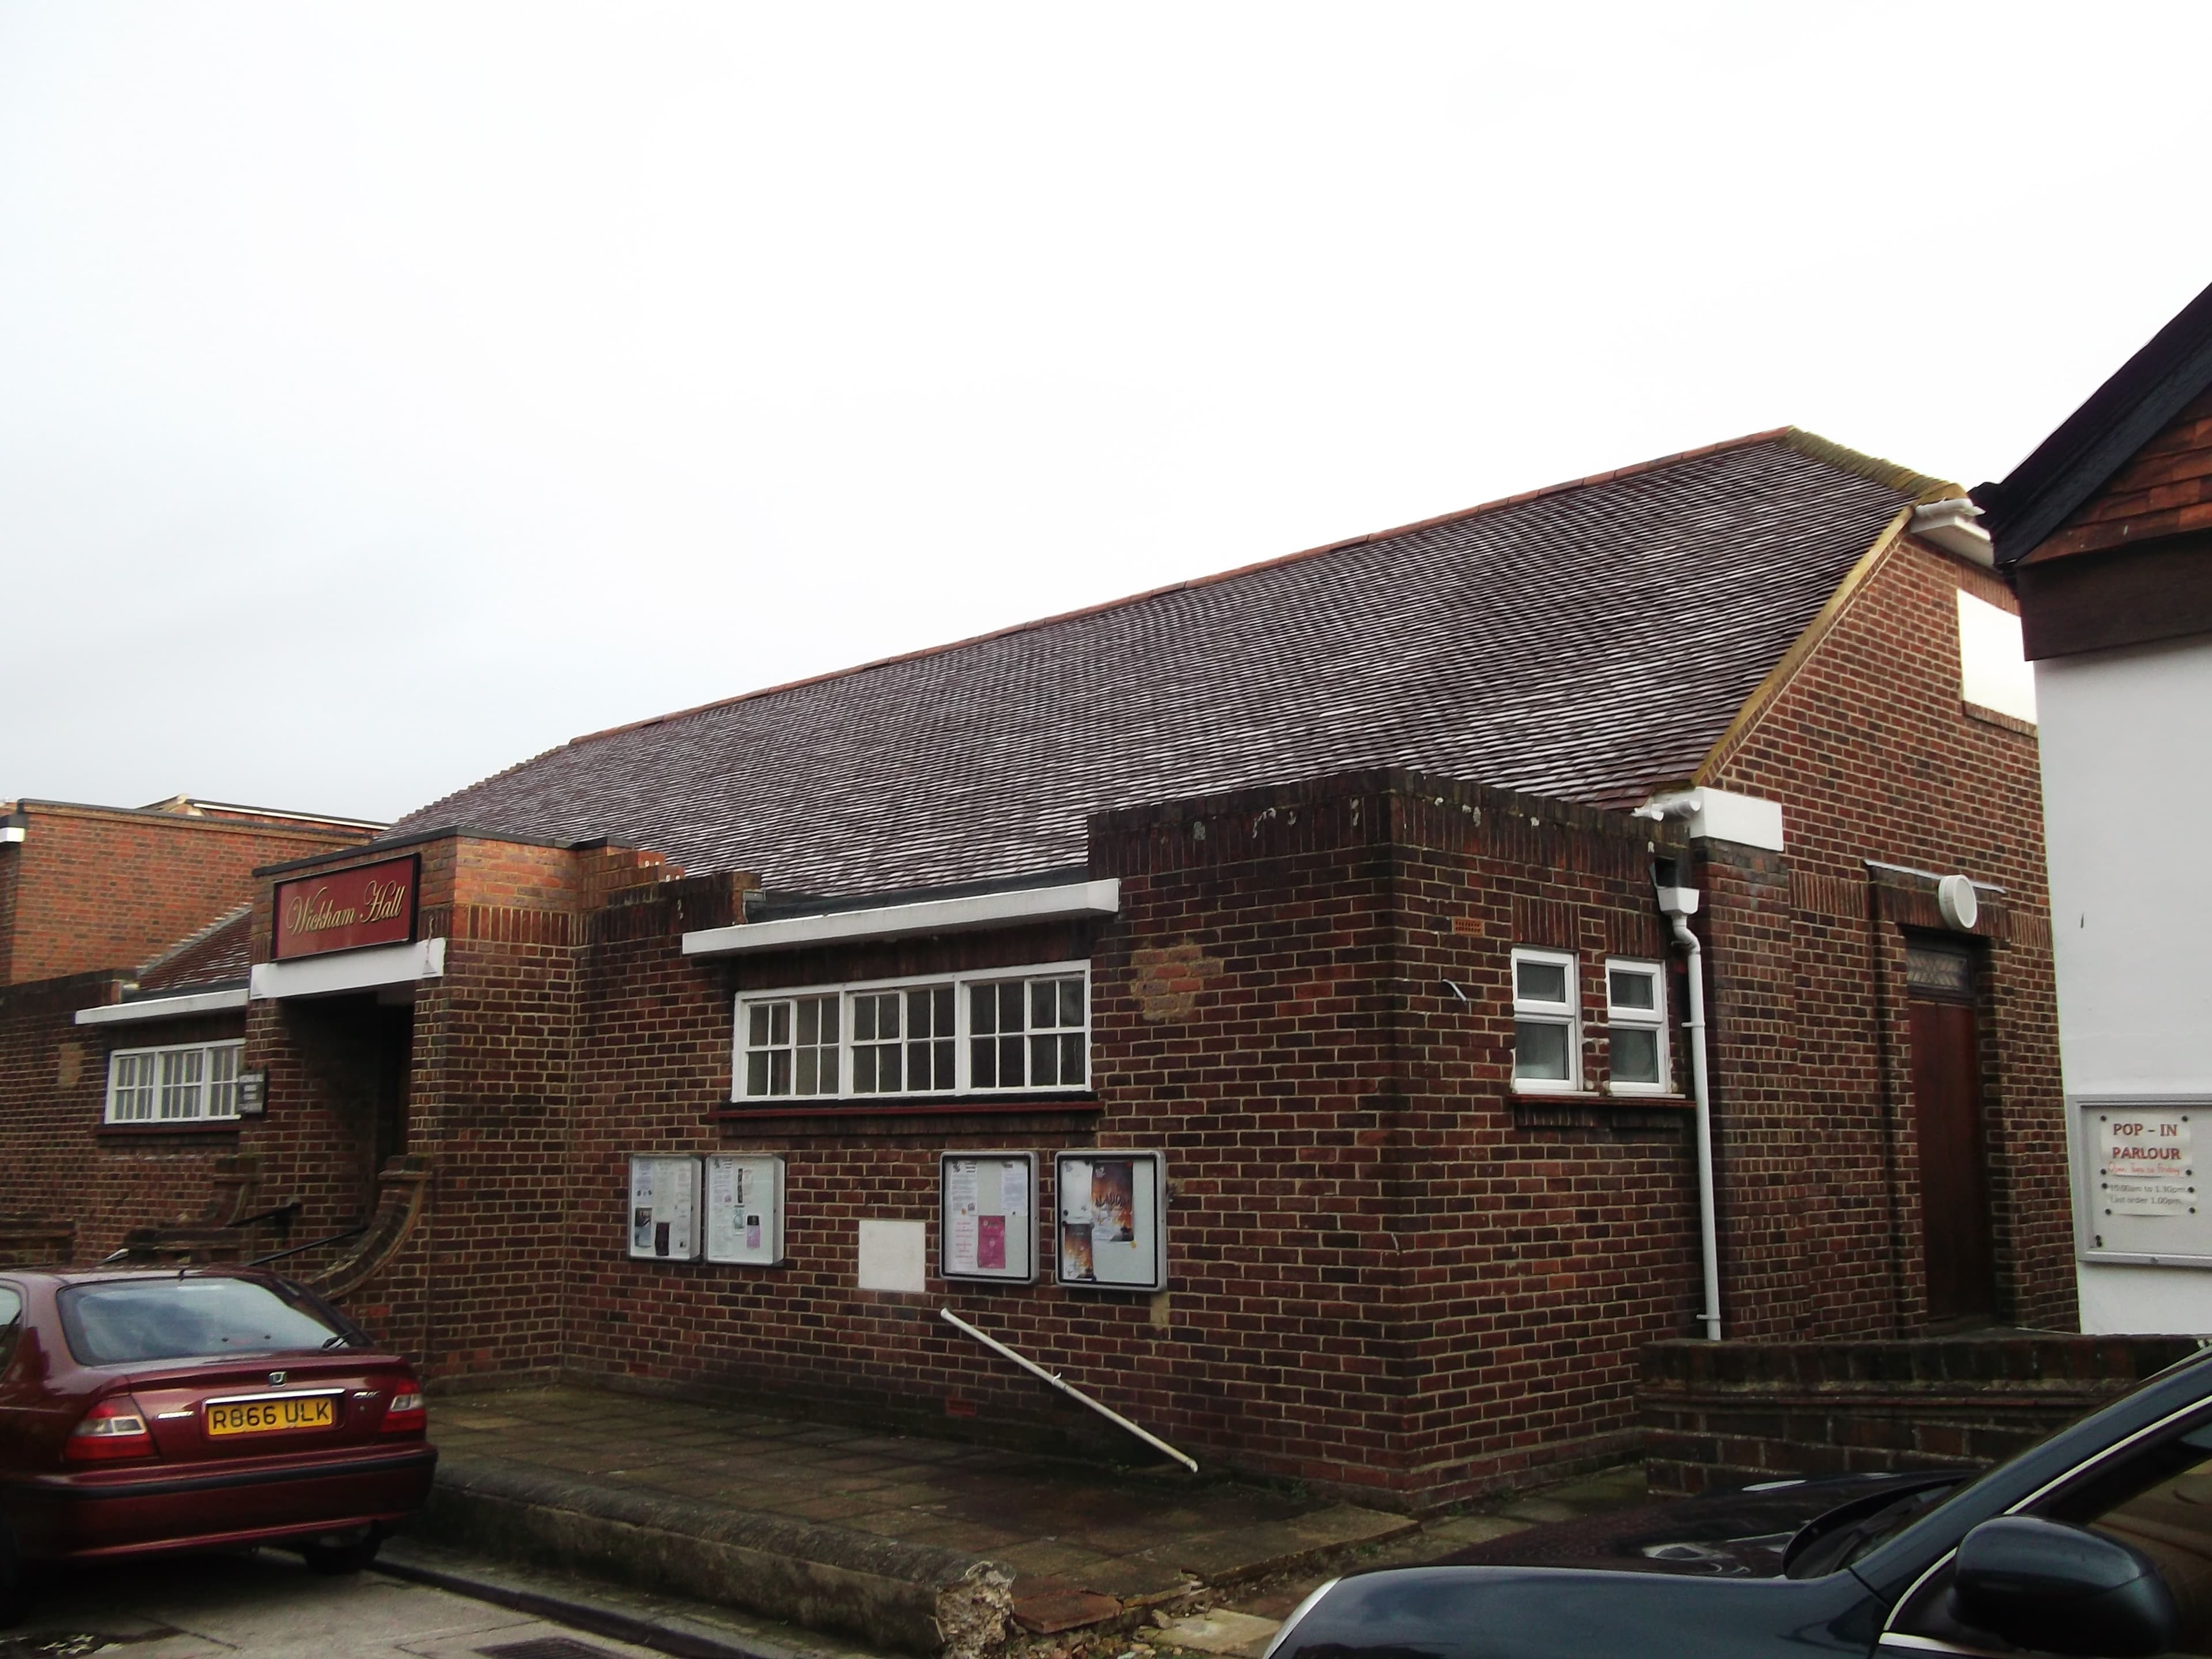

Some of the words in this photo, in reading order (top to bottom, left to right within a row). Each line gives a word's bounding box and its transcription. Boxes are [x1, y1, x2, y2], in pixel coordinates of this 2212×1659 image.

[286, 886, 355, 935] Wickham
[359, 880, 406, 922] Hall
[2113, 1123, 2143, 1136] POP
[2160, 1124, 2178, 1137] IN
[2112, 1147, 2181, 1160] PARLOUR
[213, 1406, 276, 1430] R866
[285, 1402, 329, 1423] ULK
